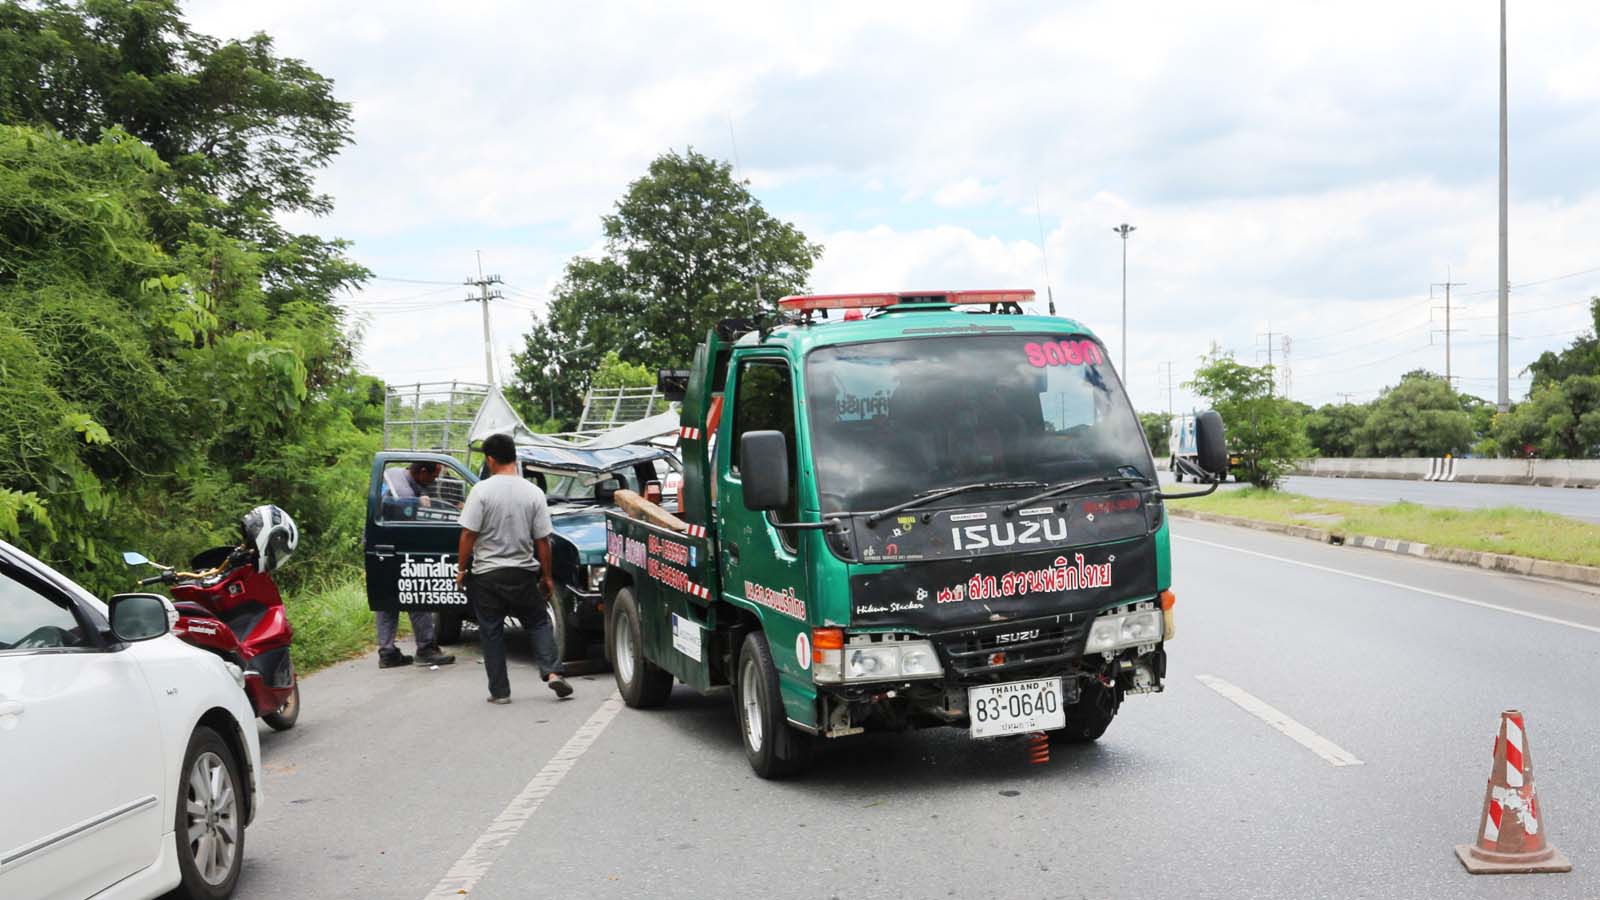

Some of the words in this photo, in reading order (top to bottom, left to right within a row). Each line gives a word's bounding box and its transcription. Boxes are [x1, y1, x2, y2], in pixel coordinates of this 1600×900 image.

[1023, 340, 1102, 368] รถยก
[951, 517, 1068, 551] ISUZU
[398, 578, 467, 592] 091712287
[398, 591, 468, 605] 0917356655
[995, 629, 1040, 645] ISUZU
[991, 682, 1040, 695] THAILAND
[976, 690, 1057, 723] 83-0640
